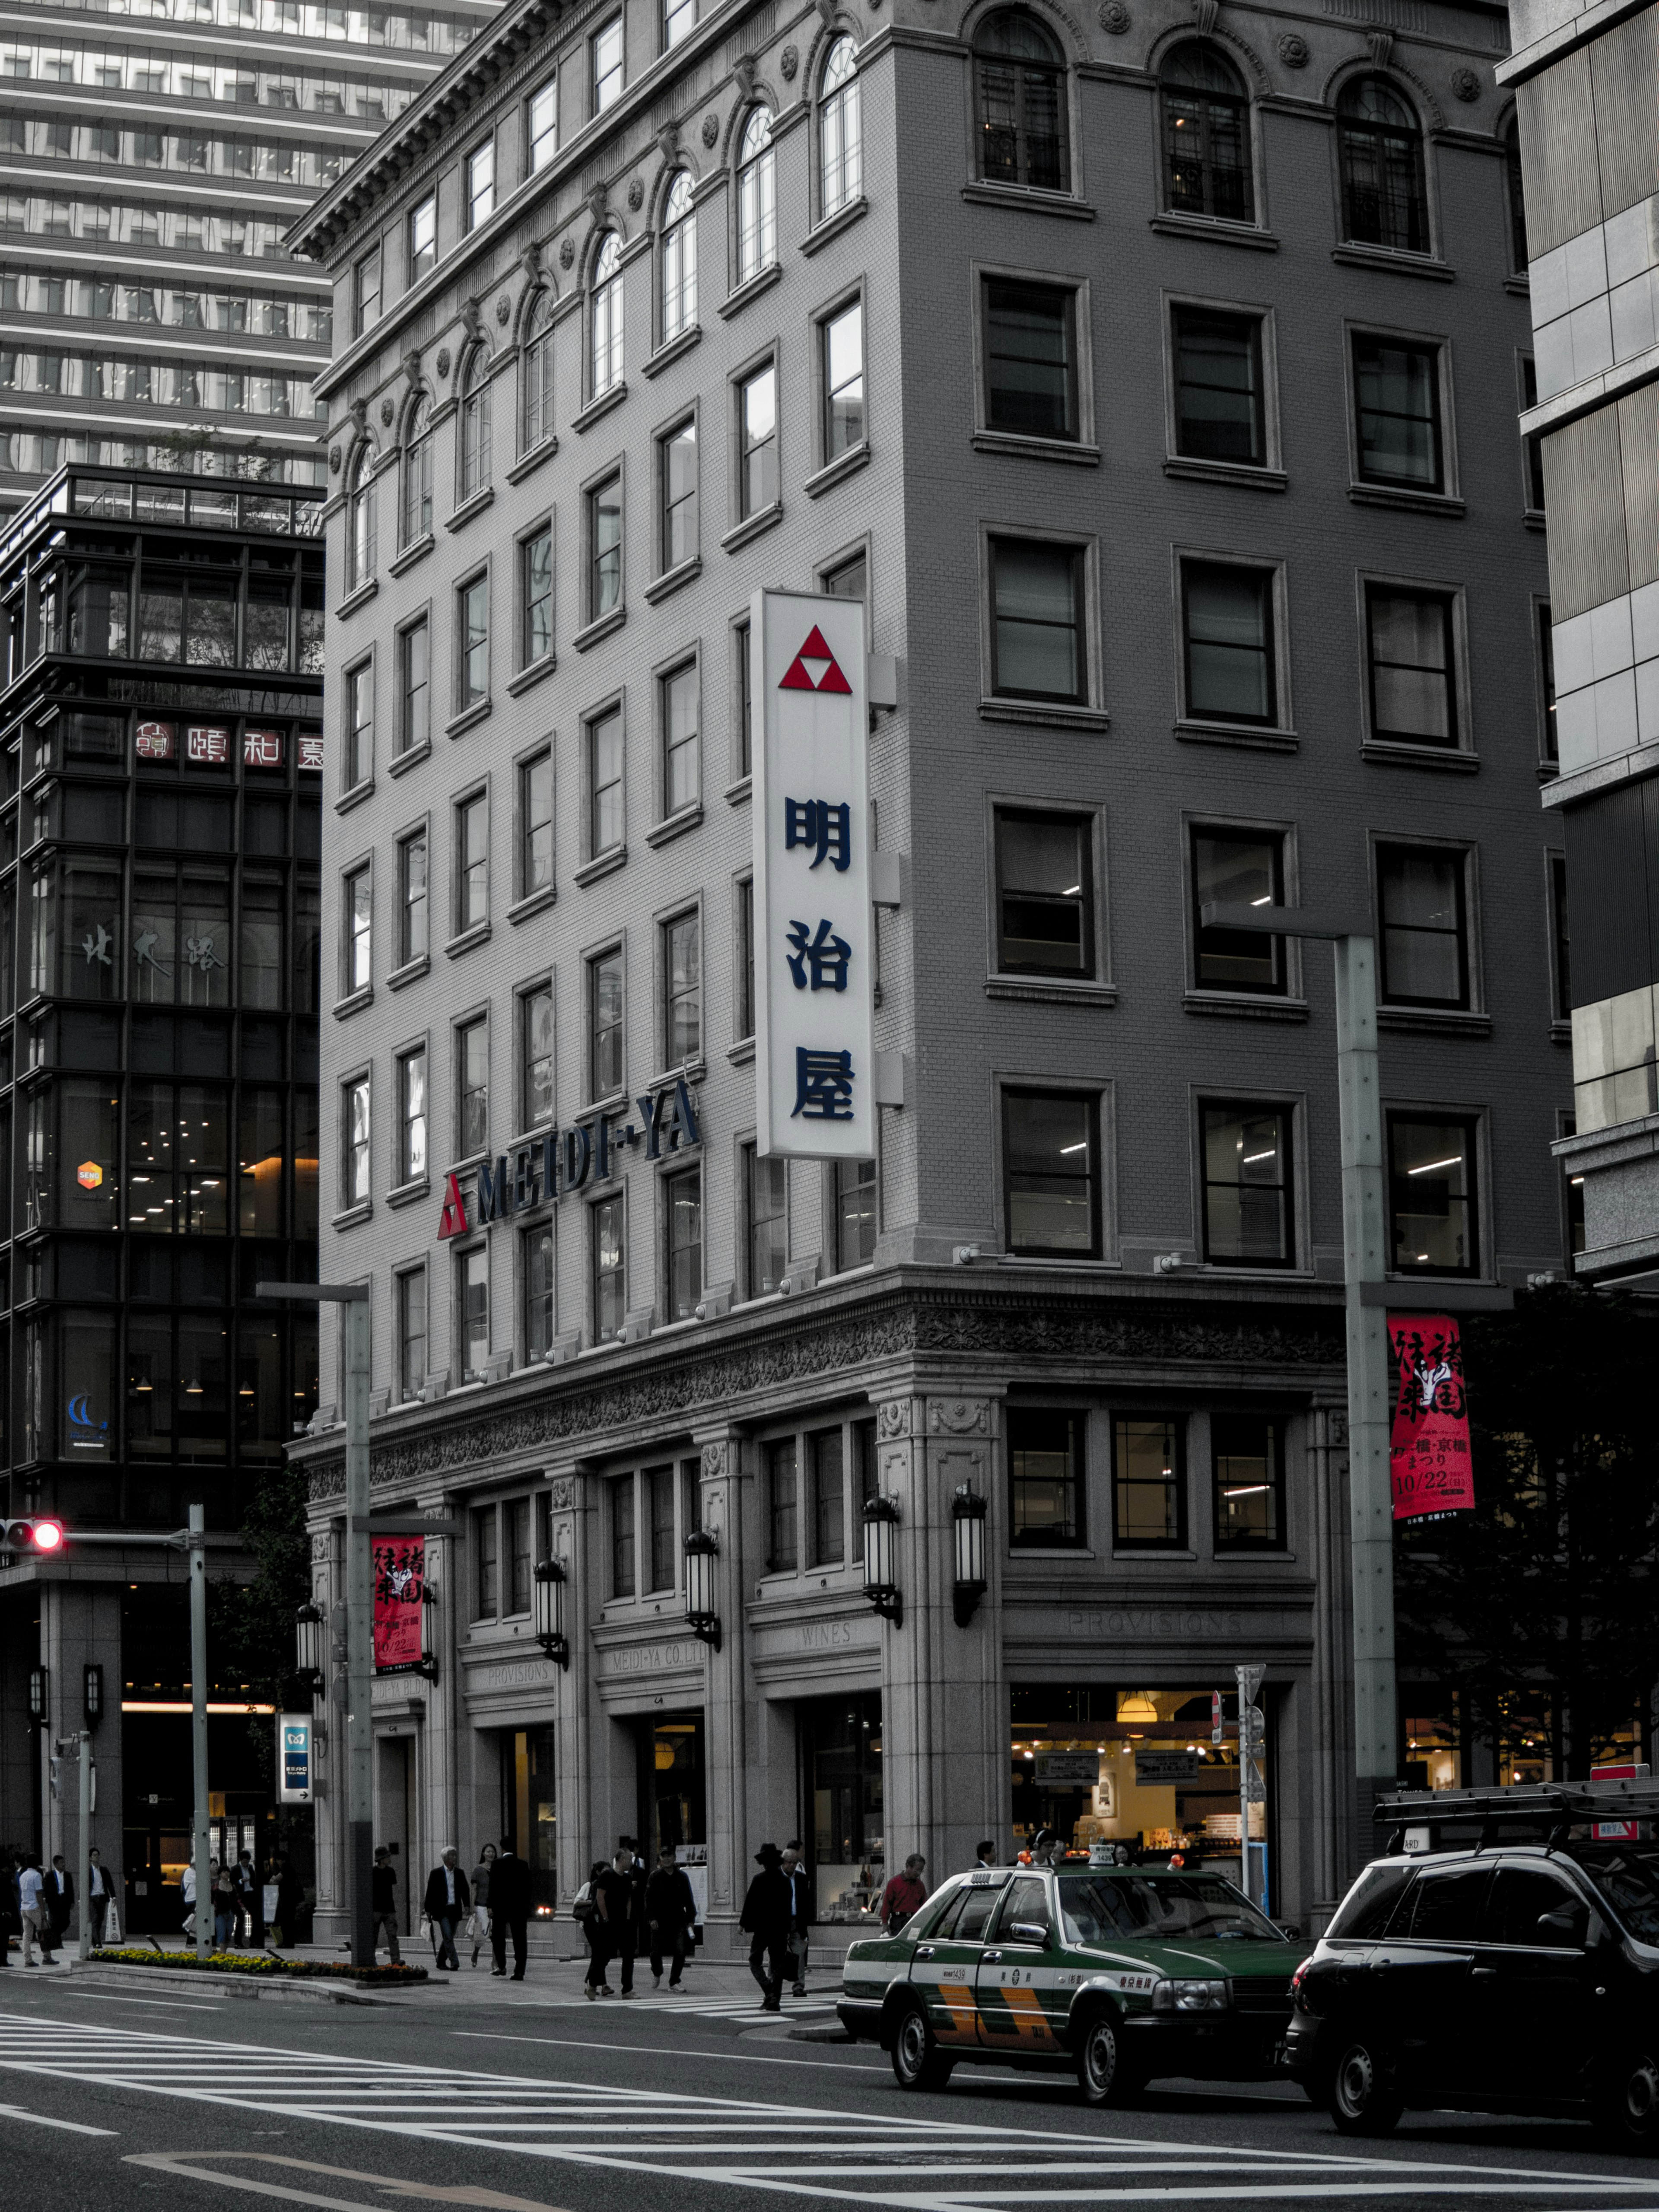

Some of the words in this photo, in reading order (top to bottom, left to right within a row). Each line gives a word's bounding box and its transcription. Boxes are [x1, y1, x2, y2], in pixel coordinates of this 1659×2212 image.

[785, 797, 855, 1121] 明治屋
[477, 1080, 700, 1224] MEIDI-YA
[1408, 1453, 1446, 1470] まつり
[1396, 1470, 1447, 1495] 10/22
[1068, 1612, 1241, 1633] PROVISIONS
[802, 1622, 850, 1647] WINES
[613, 1648, 661, 1672] MEIDI-YA
[489, 1662, 548, 1685] PROVISIONS
[953, 1970, 966, 1979] 1439
[1120, 1976, 1152, 1989] 東京無線
[1031, 2026, 1046, 2039] TAXI
